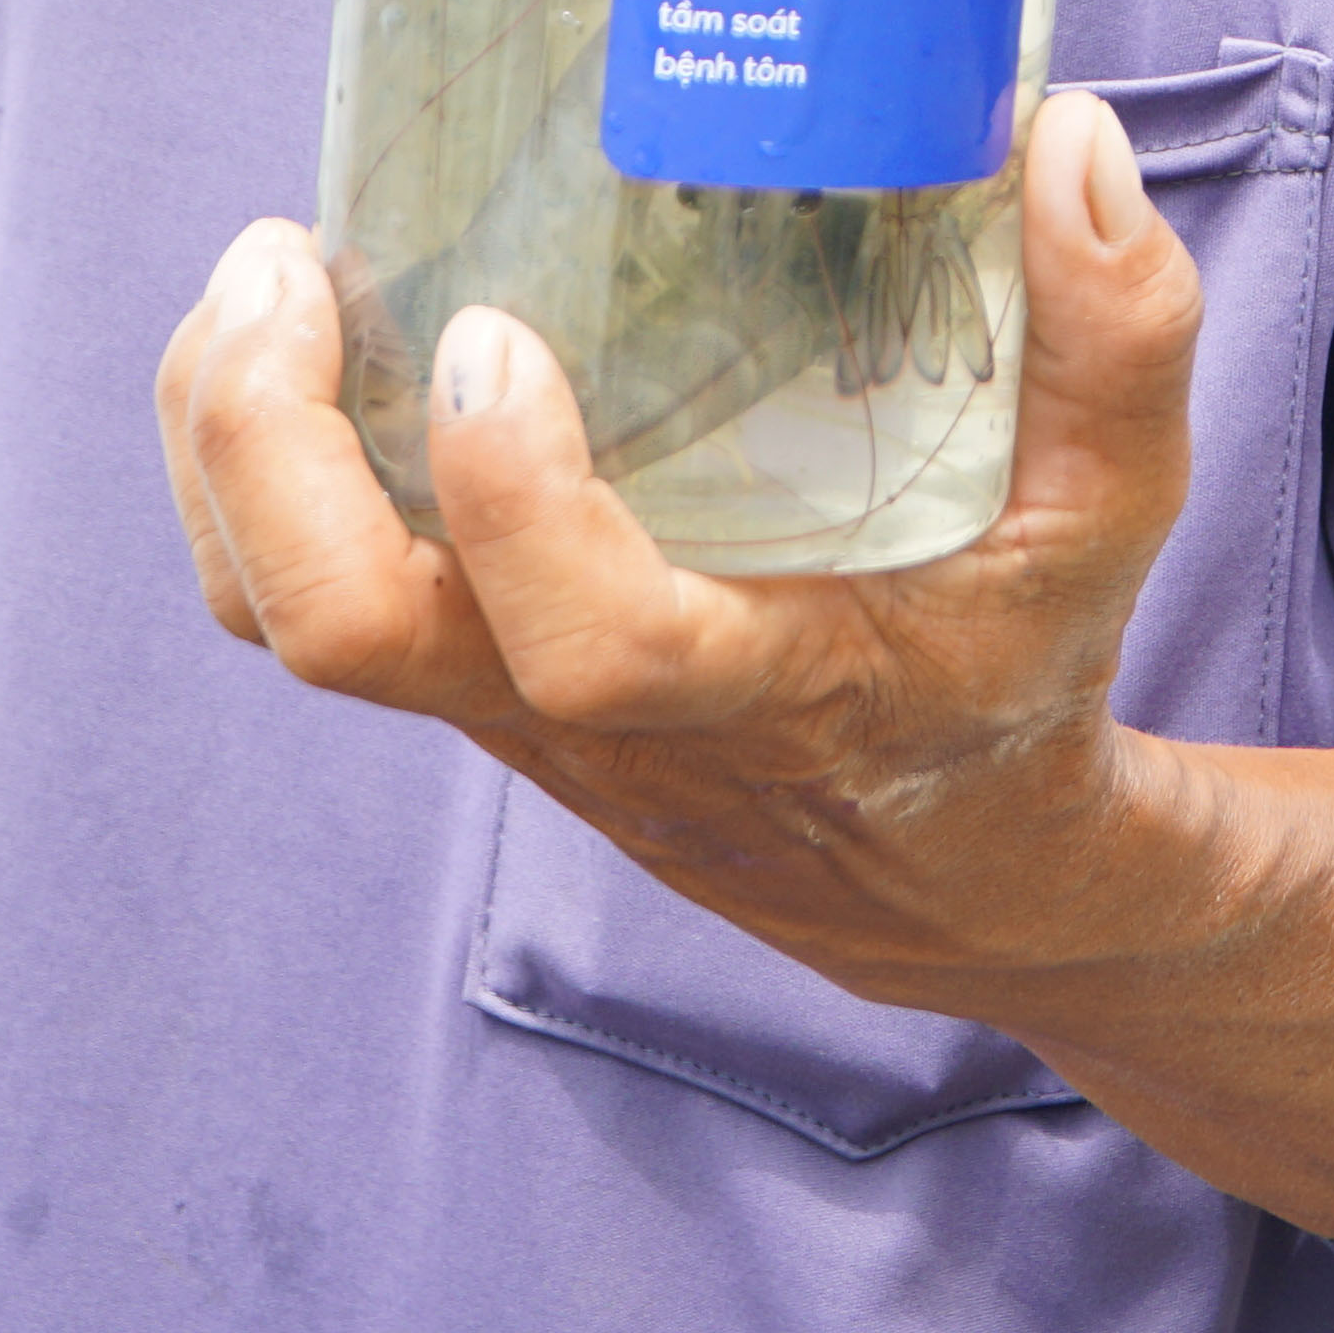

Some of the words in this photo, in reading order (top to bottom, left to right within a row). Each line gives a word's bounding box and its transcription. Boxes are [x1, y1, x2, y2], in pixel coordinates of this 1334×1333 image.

[730, 7, 802, 40] soát
[653, 46, 737, 89] bệnh
[743, 55, 808, 87] tôm
